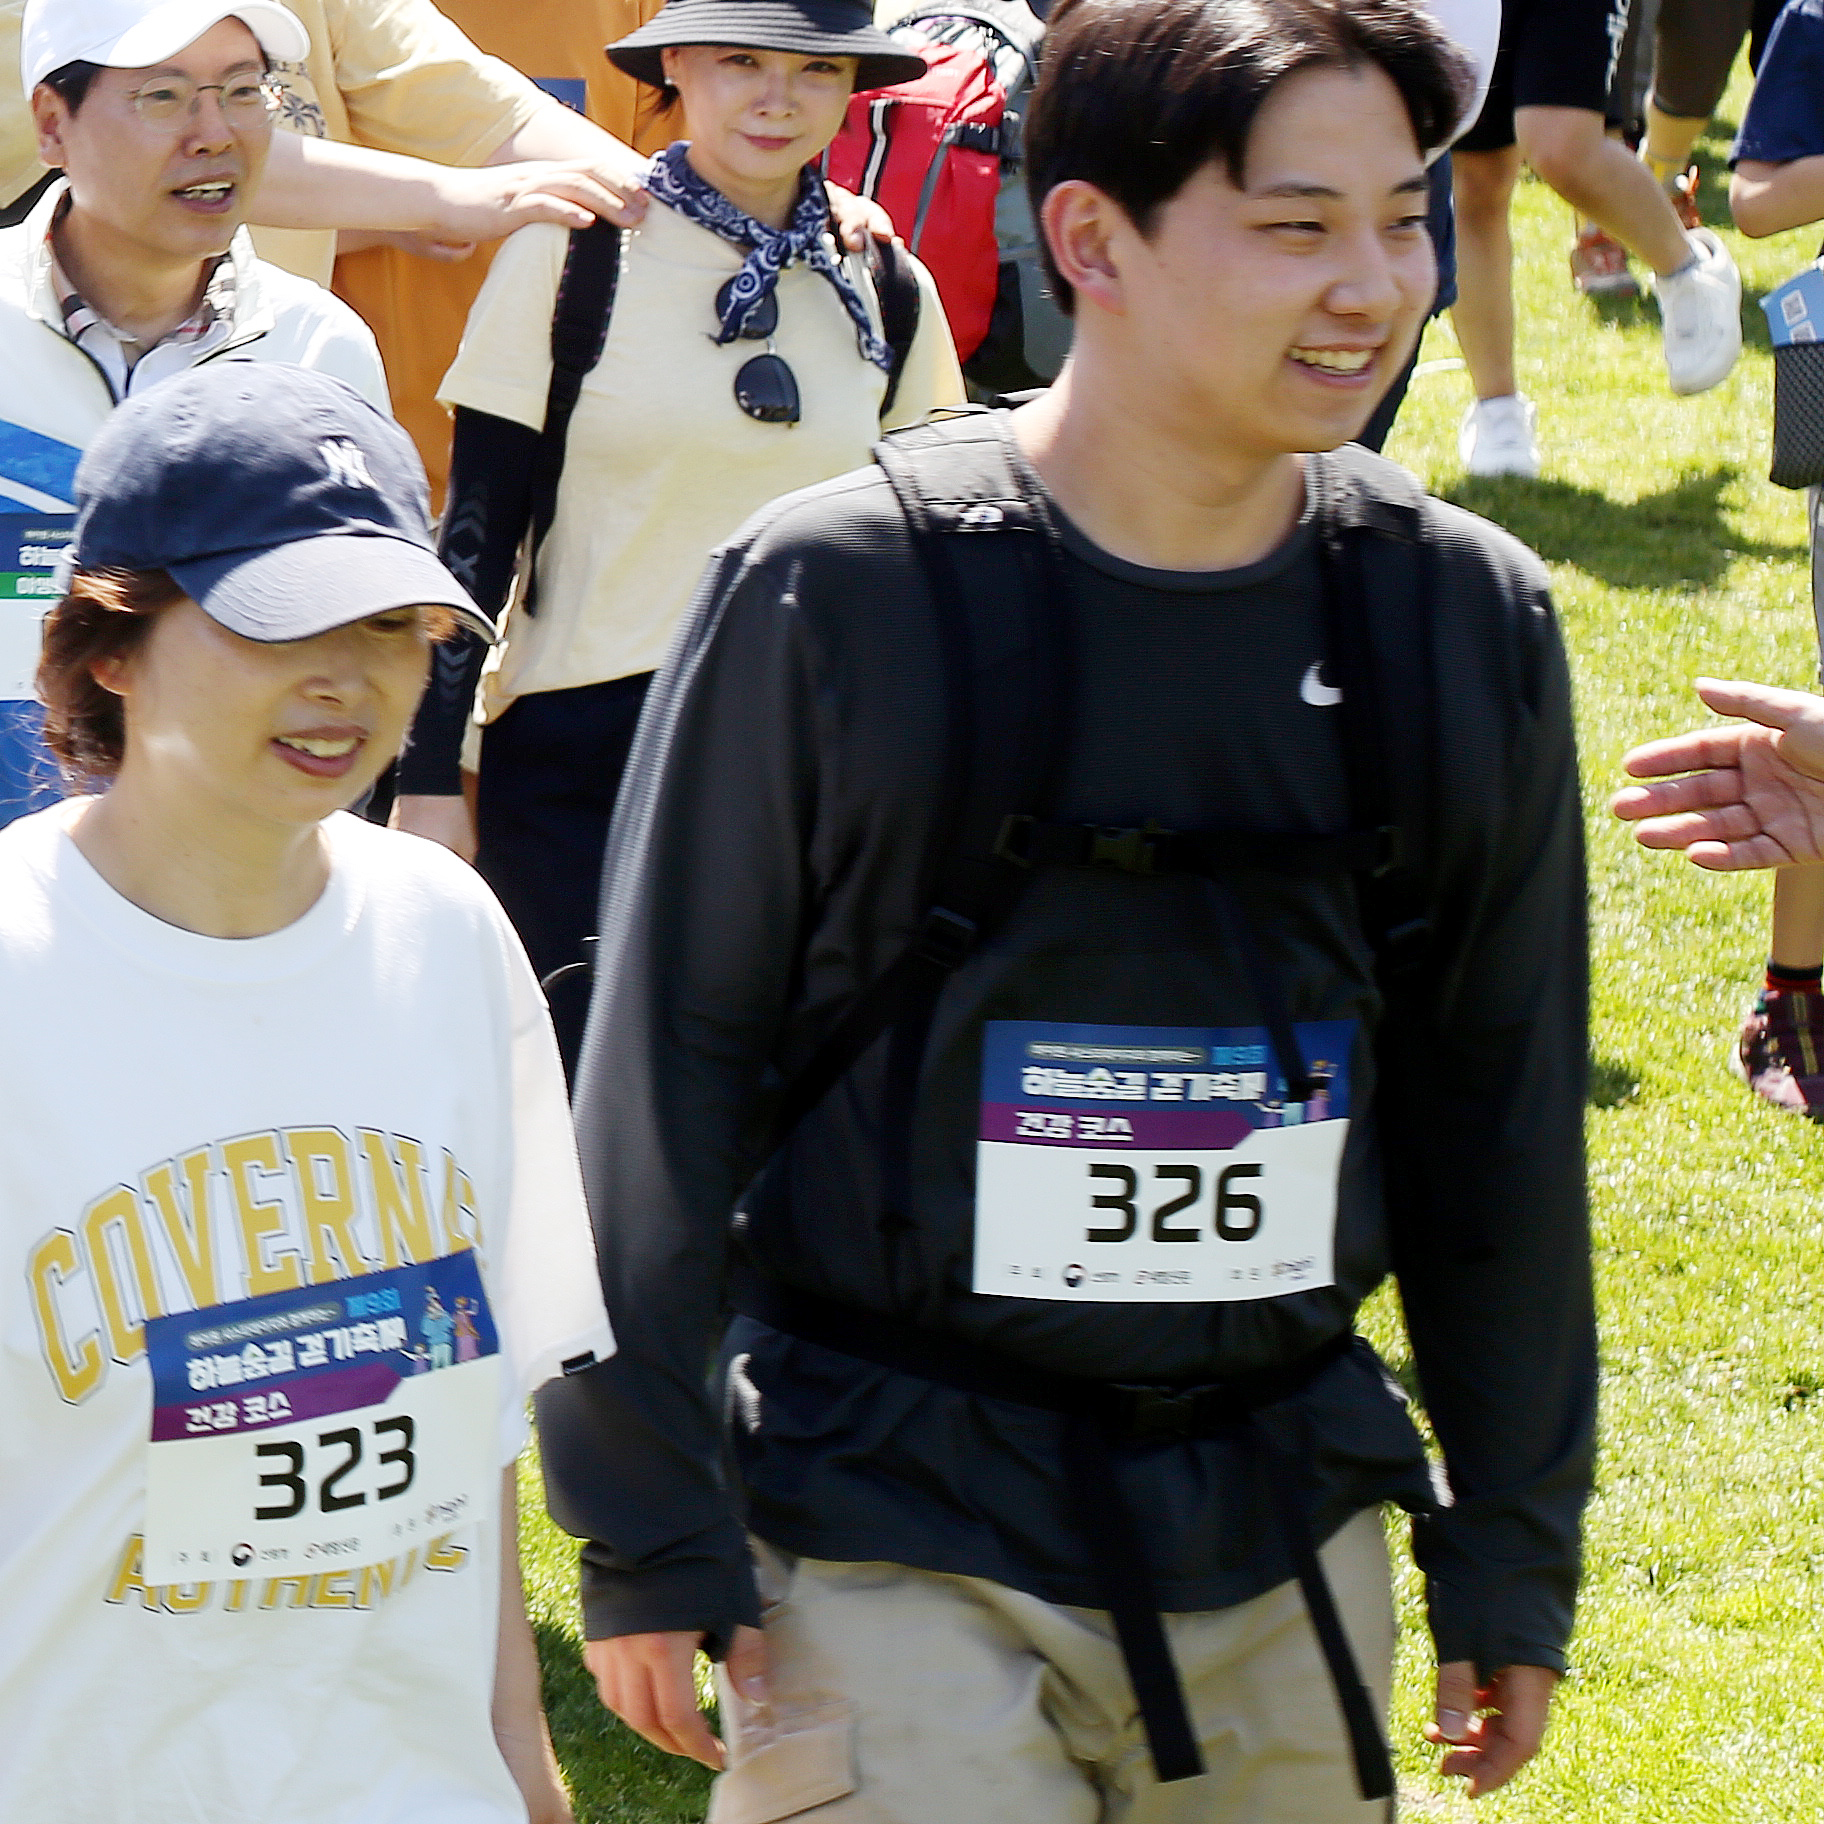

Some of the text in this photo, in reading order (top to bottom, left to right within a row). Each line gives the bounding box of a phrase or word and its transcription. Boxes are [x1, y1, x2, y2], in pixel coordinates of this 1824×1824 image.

[1021, 1066, 1149, 1102] 하늘숲길
[1014, 1110, 1135, 1143] 건강 코스
[1085, 1162, 1266, 1244] 326
[185, 1338, 295, 1394] 하늘숲길
[297, 1316, 410, 1370] 걷기축제
[185, 1390, 294, 1435] 건강 코스
[254, 1414, 417, 1522] 323
